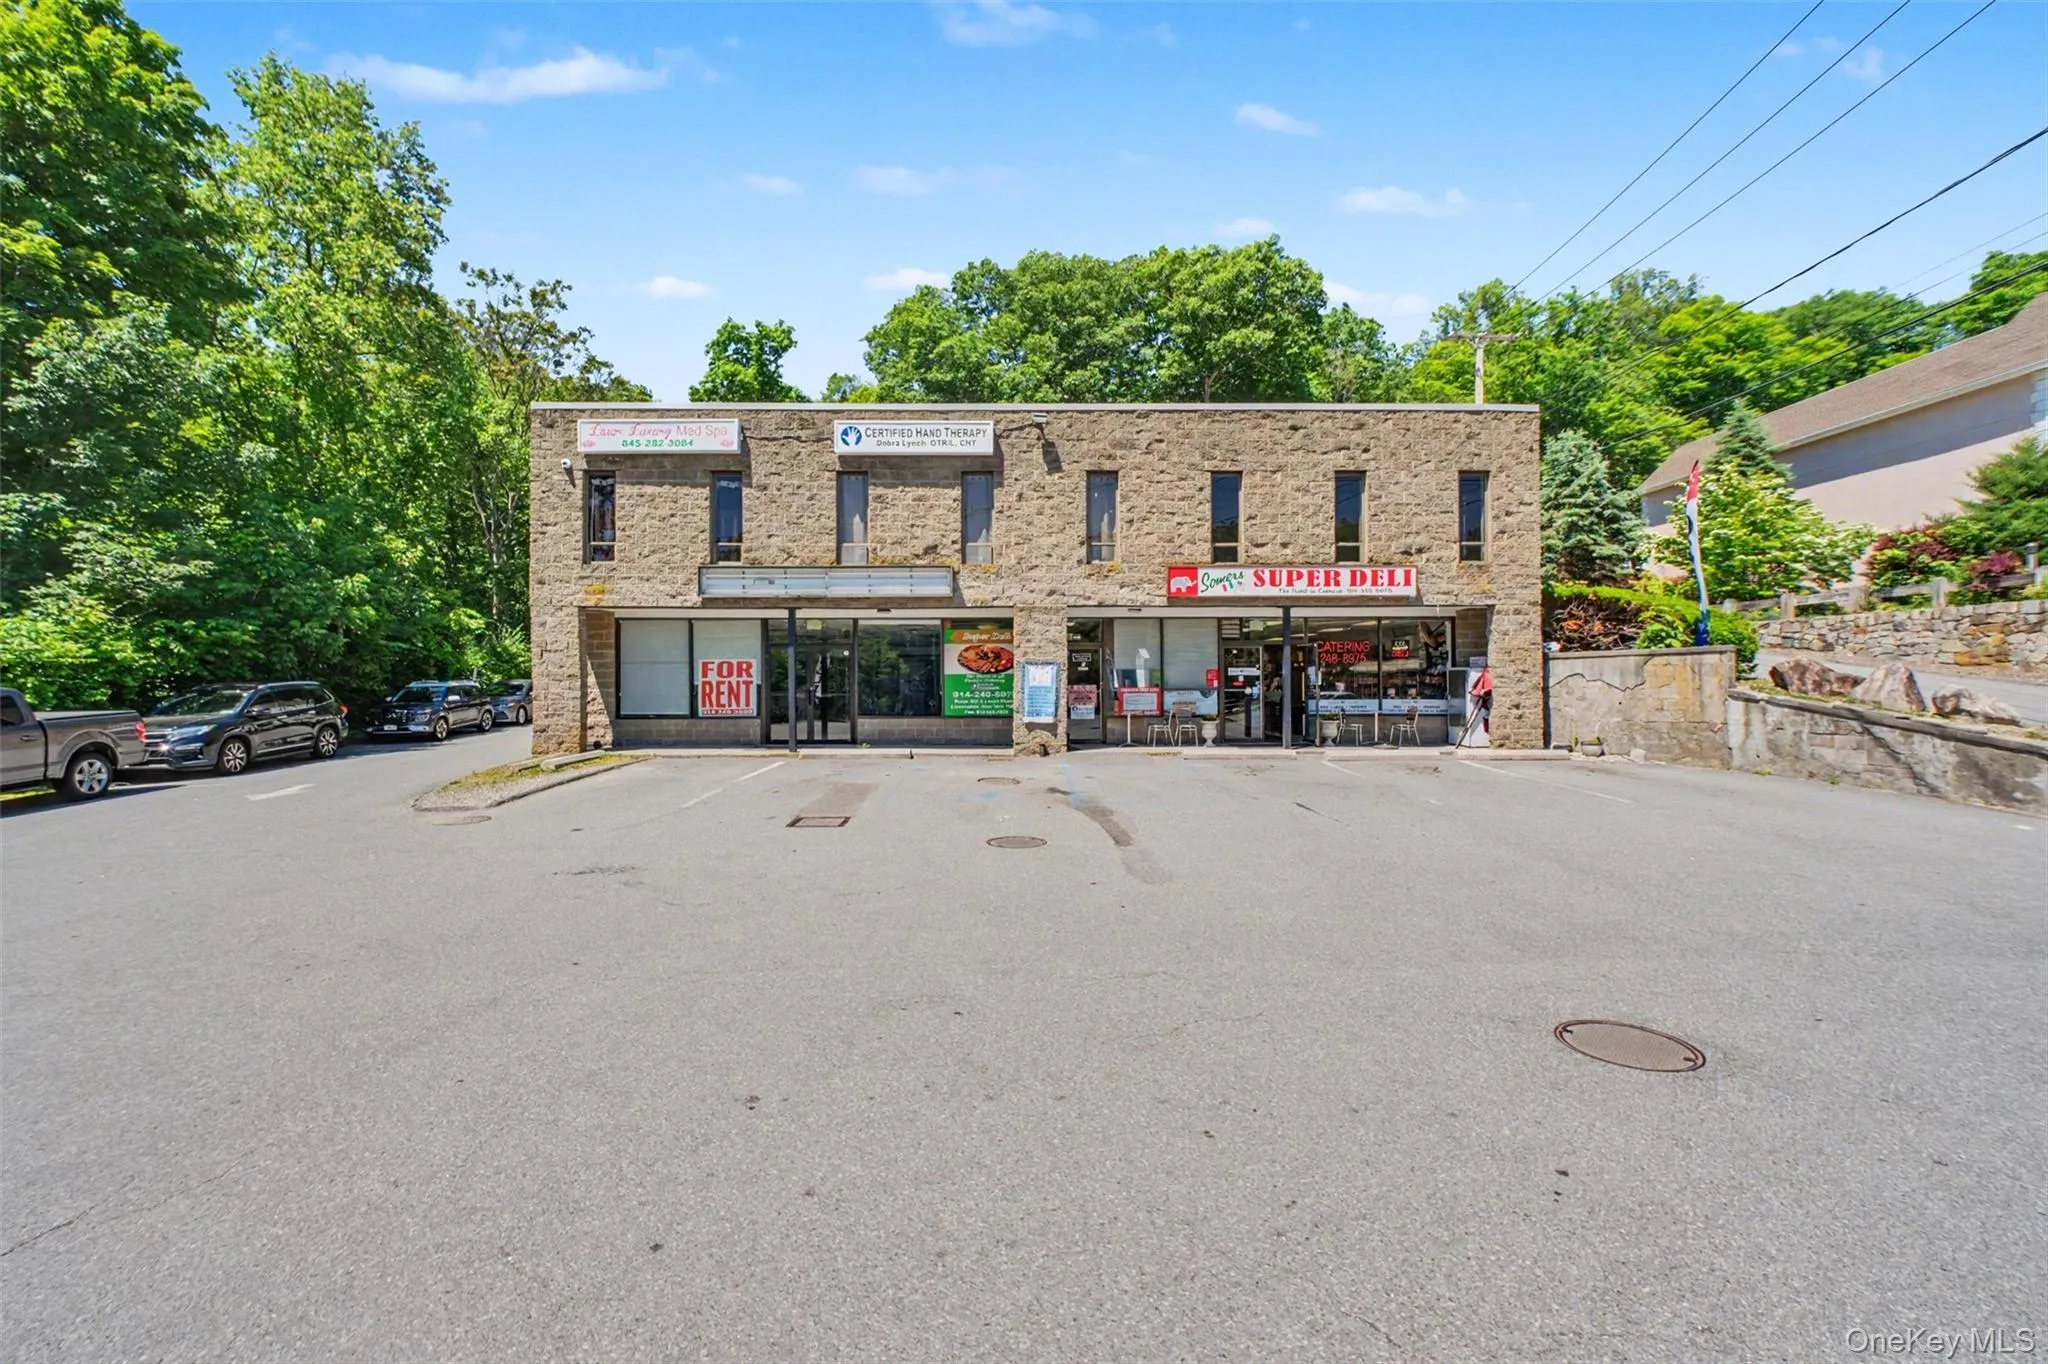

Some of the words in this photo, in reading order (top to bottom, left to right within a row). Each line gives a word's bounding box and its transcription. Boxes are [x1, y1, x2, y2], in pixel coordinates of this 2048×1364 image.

[676, 425, 701, 437] Med
[704, 425, 728, 439] Spa
[864, 427, 913, 438] CERTIFIED
[915, 427, 942, 438] HAND
[944, 427, 988, 438] THERAPY
[902, 439, 927, 448] Lynch
[1200, 571, 1245, 593] Somers
[1253, 568, 1342, 587] SUPER
[1349, 568, 1413, 587] DELI
[1316, 640, 1370, 652] CATERING
[1320, 652, 1367, 664] 248-8975
[701, 661, 753, 679] FOR
[701, 680, 753, 708] RENT
